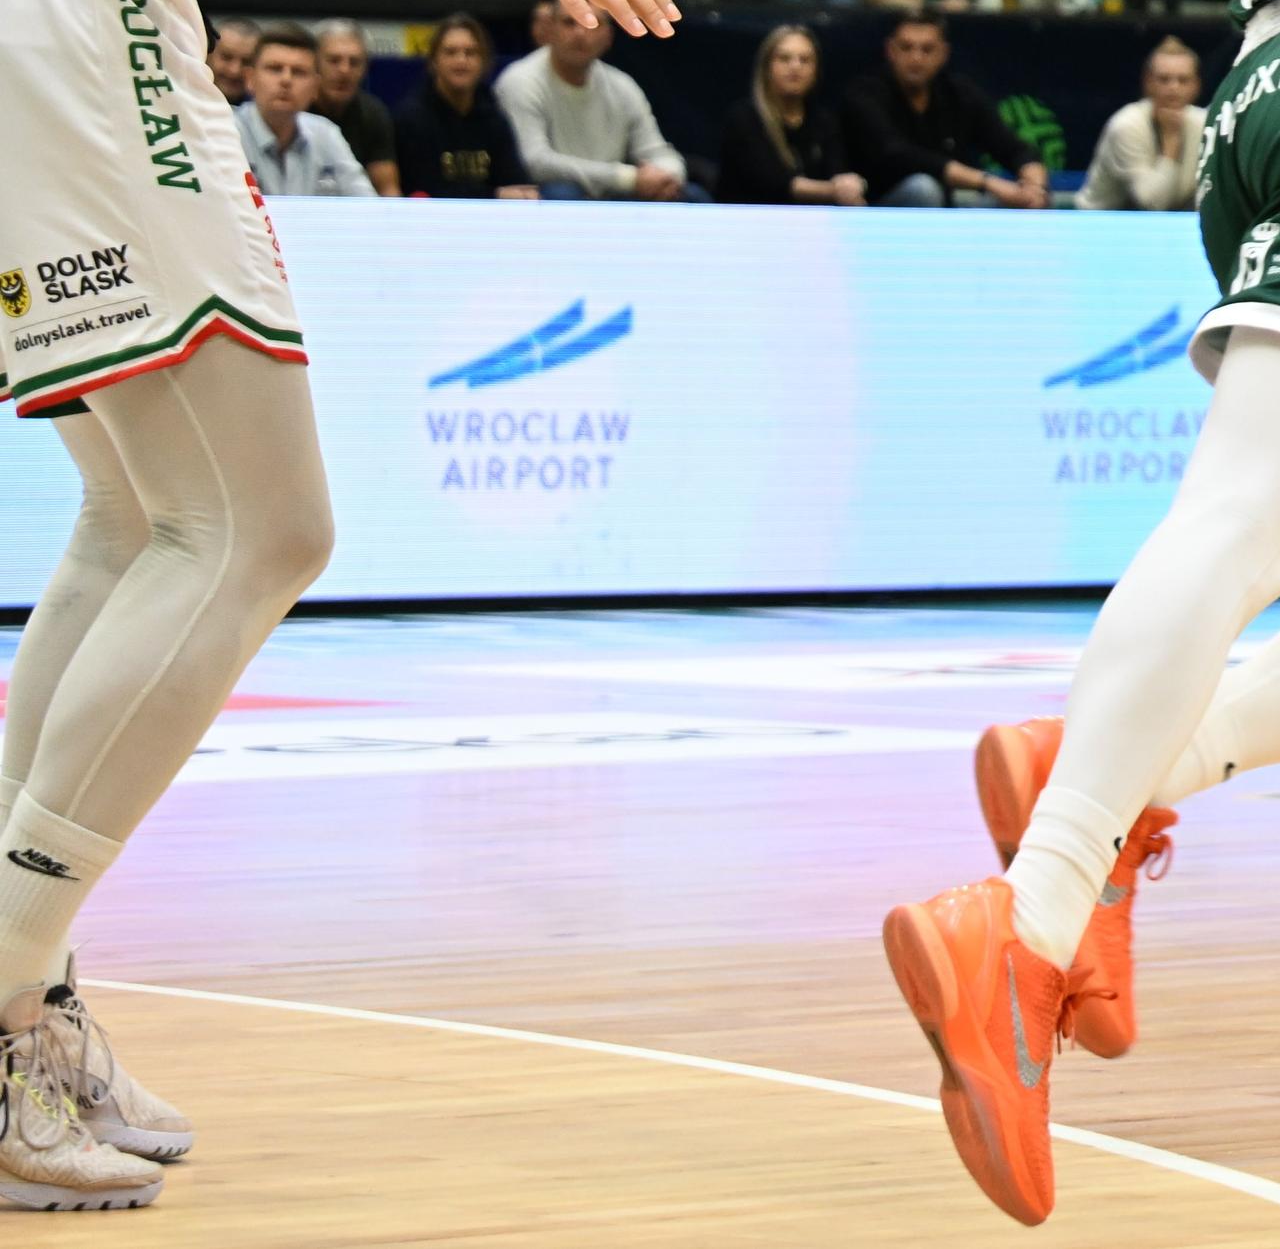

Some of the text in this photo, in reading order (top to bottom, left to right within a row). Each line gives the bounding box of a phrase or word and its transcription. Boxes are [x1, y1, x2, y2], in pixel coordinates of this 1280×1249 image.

[37, 243, 129, 283] DOLNY
[15, 302, 152, 351] dolnyslask.travel
[425, 409, 631, 442] WROCLAW
[441, 454, 613, 489] AIRPORT
[21, 848, 71, 872] NIKE
